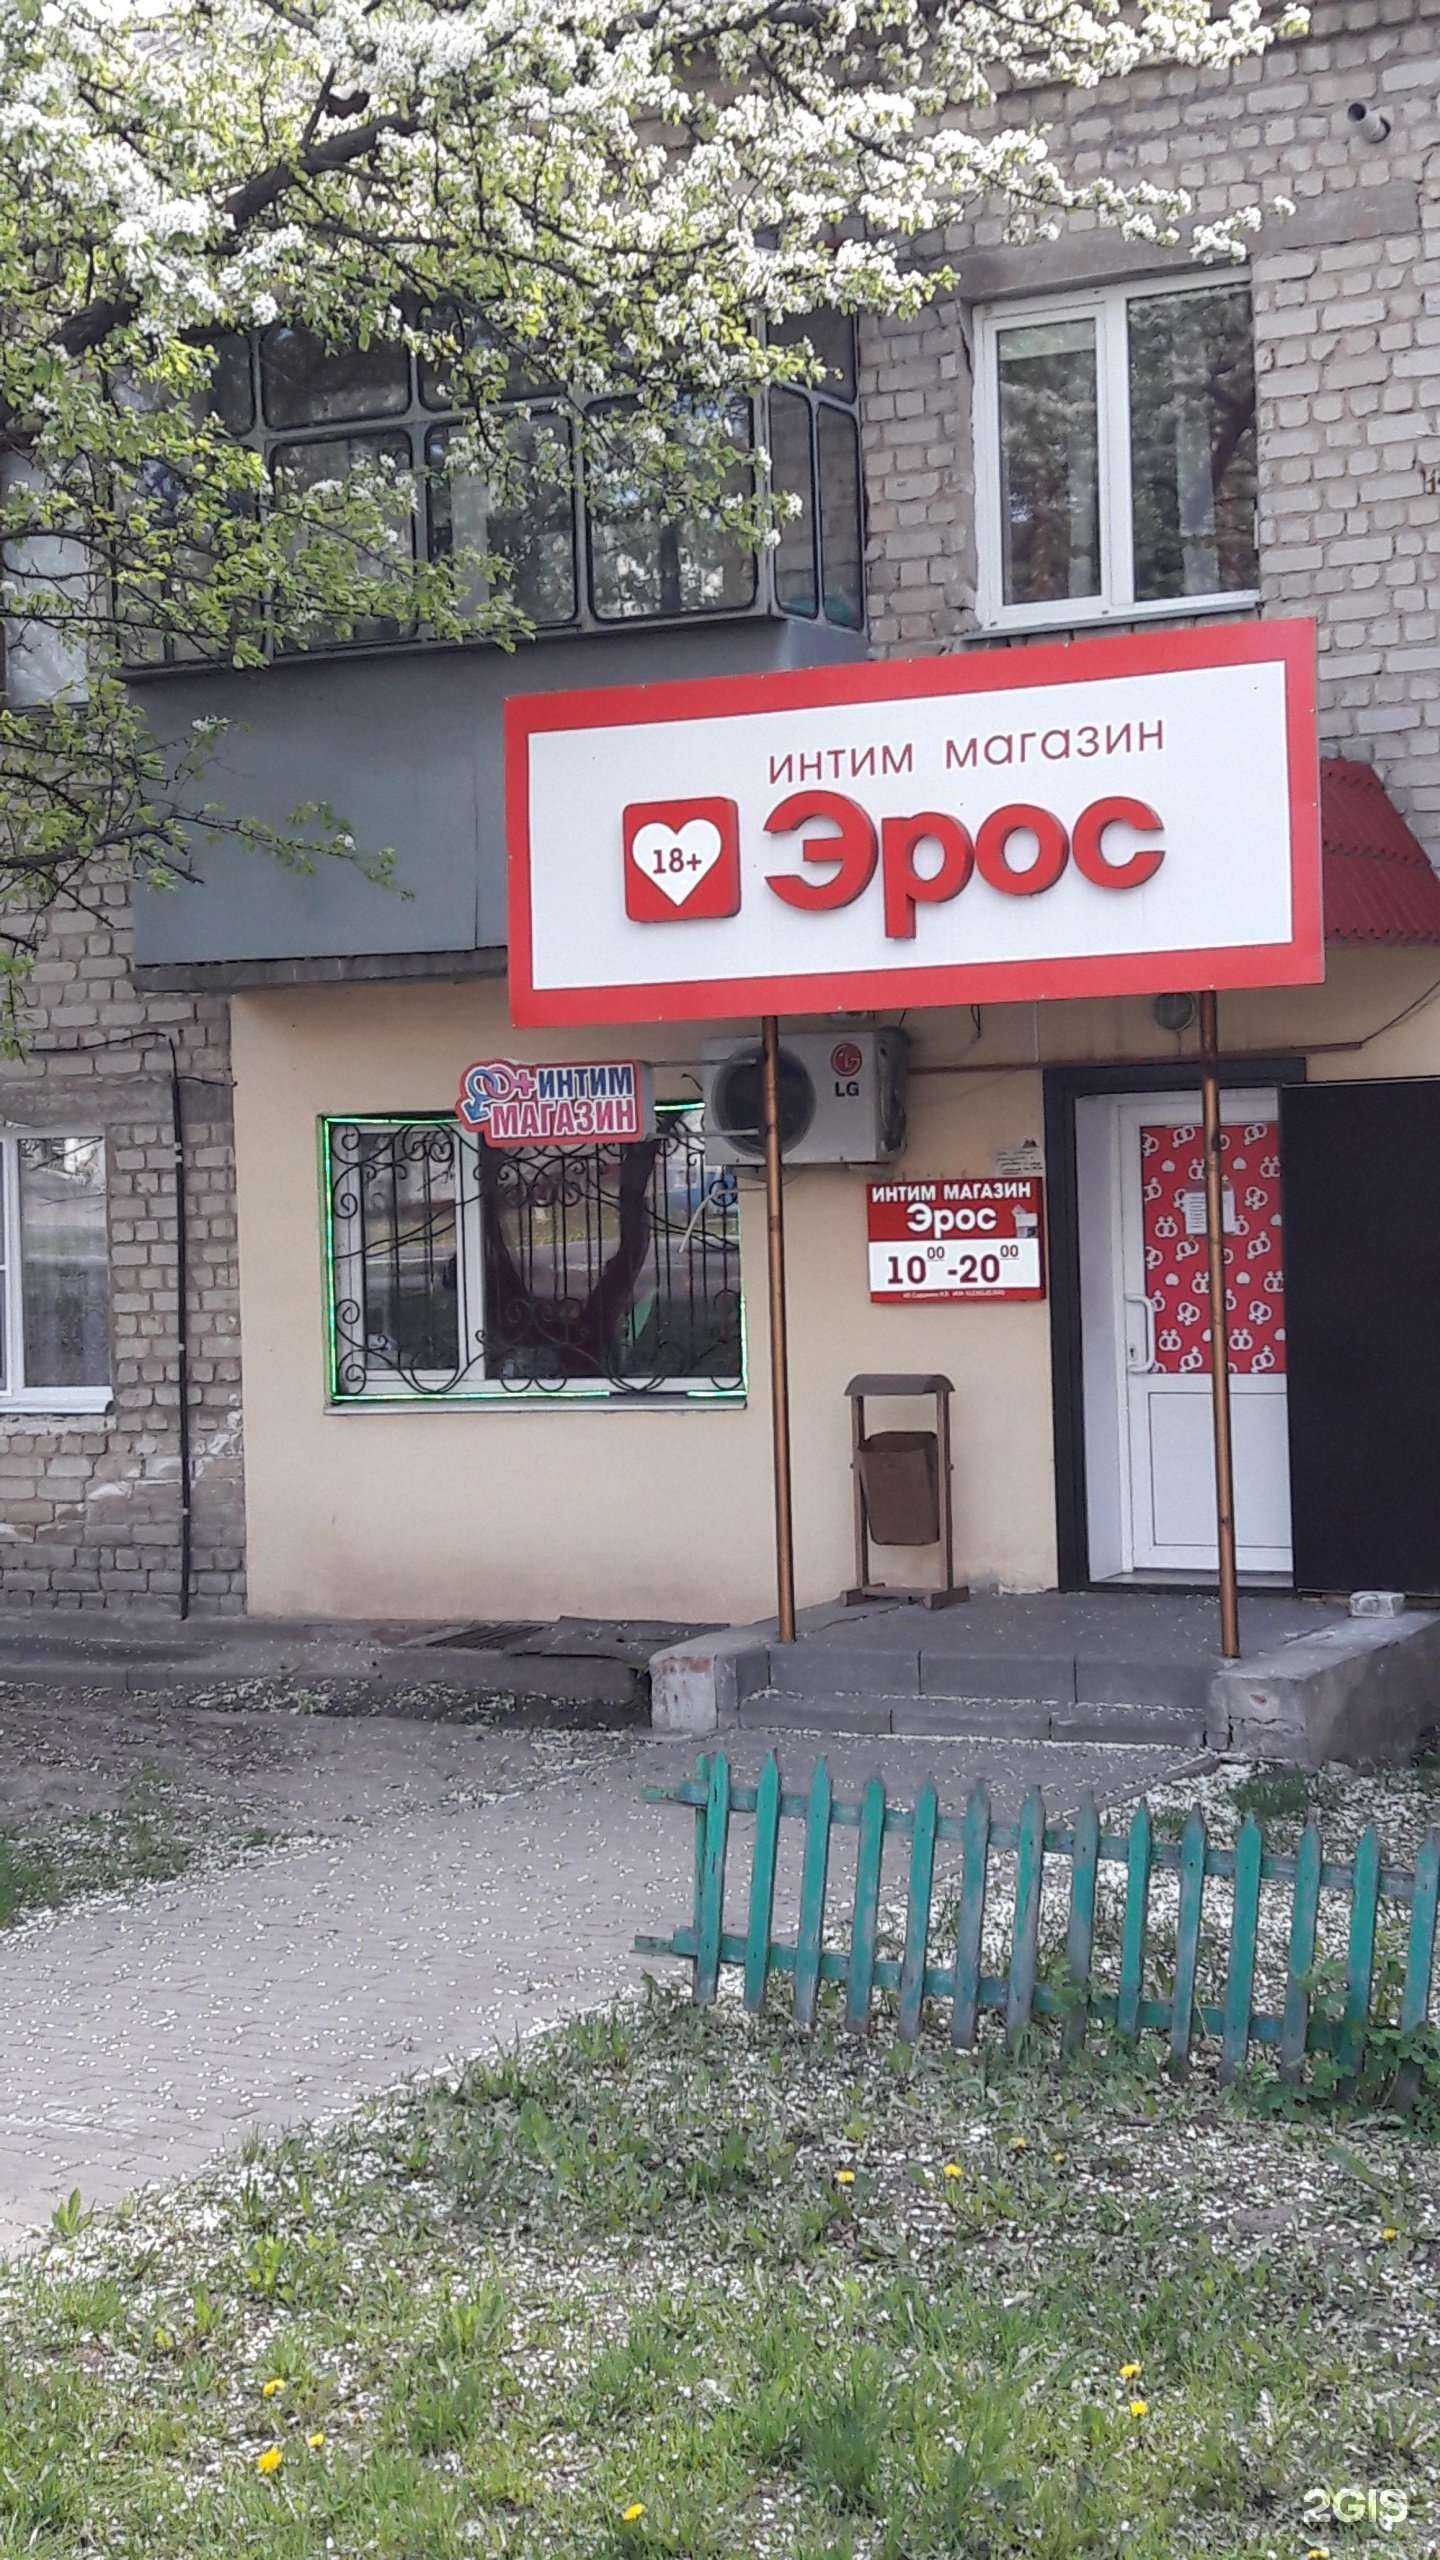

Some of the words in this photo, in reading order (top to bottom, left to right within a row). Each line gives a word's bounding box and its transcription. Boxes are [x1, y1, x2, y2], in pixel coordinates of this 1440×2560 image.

[652, 847, 702, 874] 18+
[763, 789, 1166, 939] Эрос
[538, 1064, 634, 1100] ИНТИМ
[834, 1081, 860, 1097] LG
[491, 1099, 636, 1138] МАГАЗИН
[871, 1184, 937, 1202] ИНТИМ
[943, 1182, 1031, 1200] МАГАЗИН
[906, 1202, 998, 1239] Эрос
